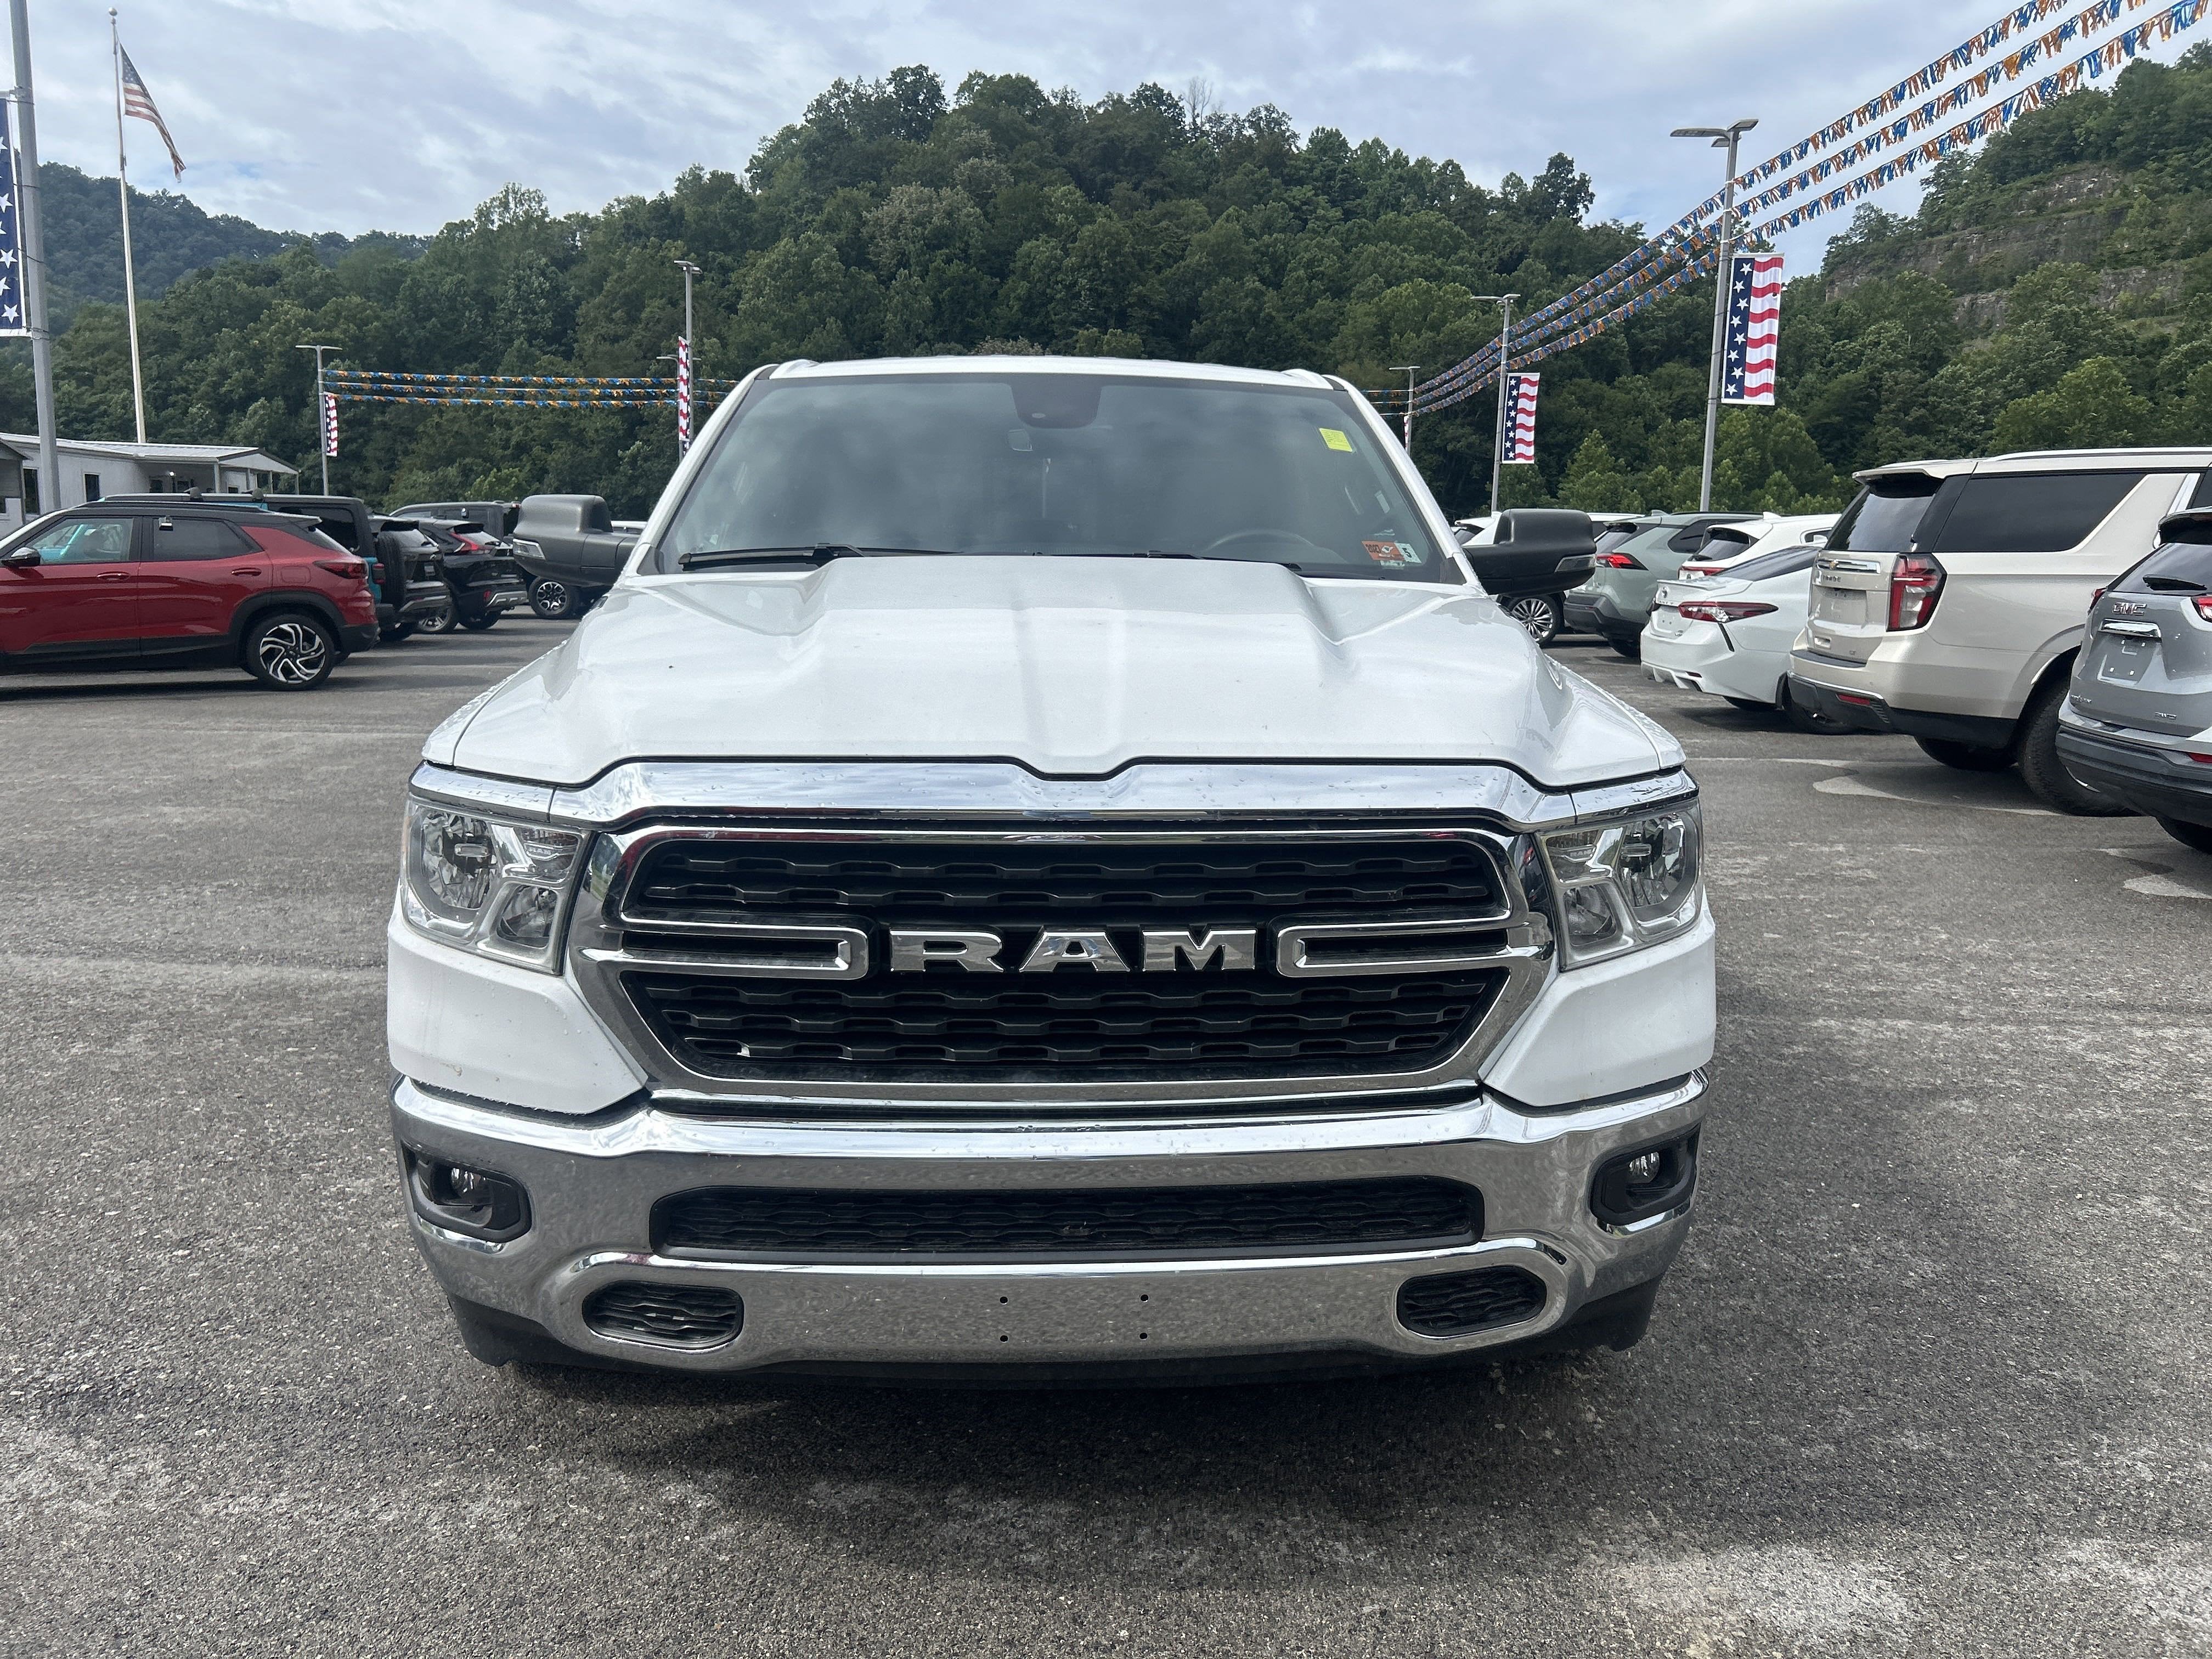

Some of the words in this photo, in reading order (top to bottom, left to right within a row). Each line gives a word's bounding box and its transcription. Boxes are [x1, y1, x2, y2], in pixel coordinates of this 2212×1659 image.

[1402, 548, 1412, 558] 5
[2113, 602, 2147, 615] GMC
[890, 929, 1257, 972] RAM
